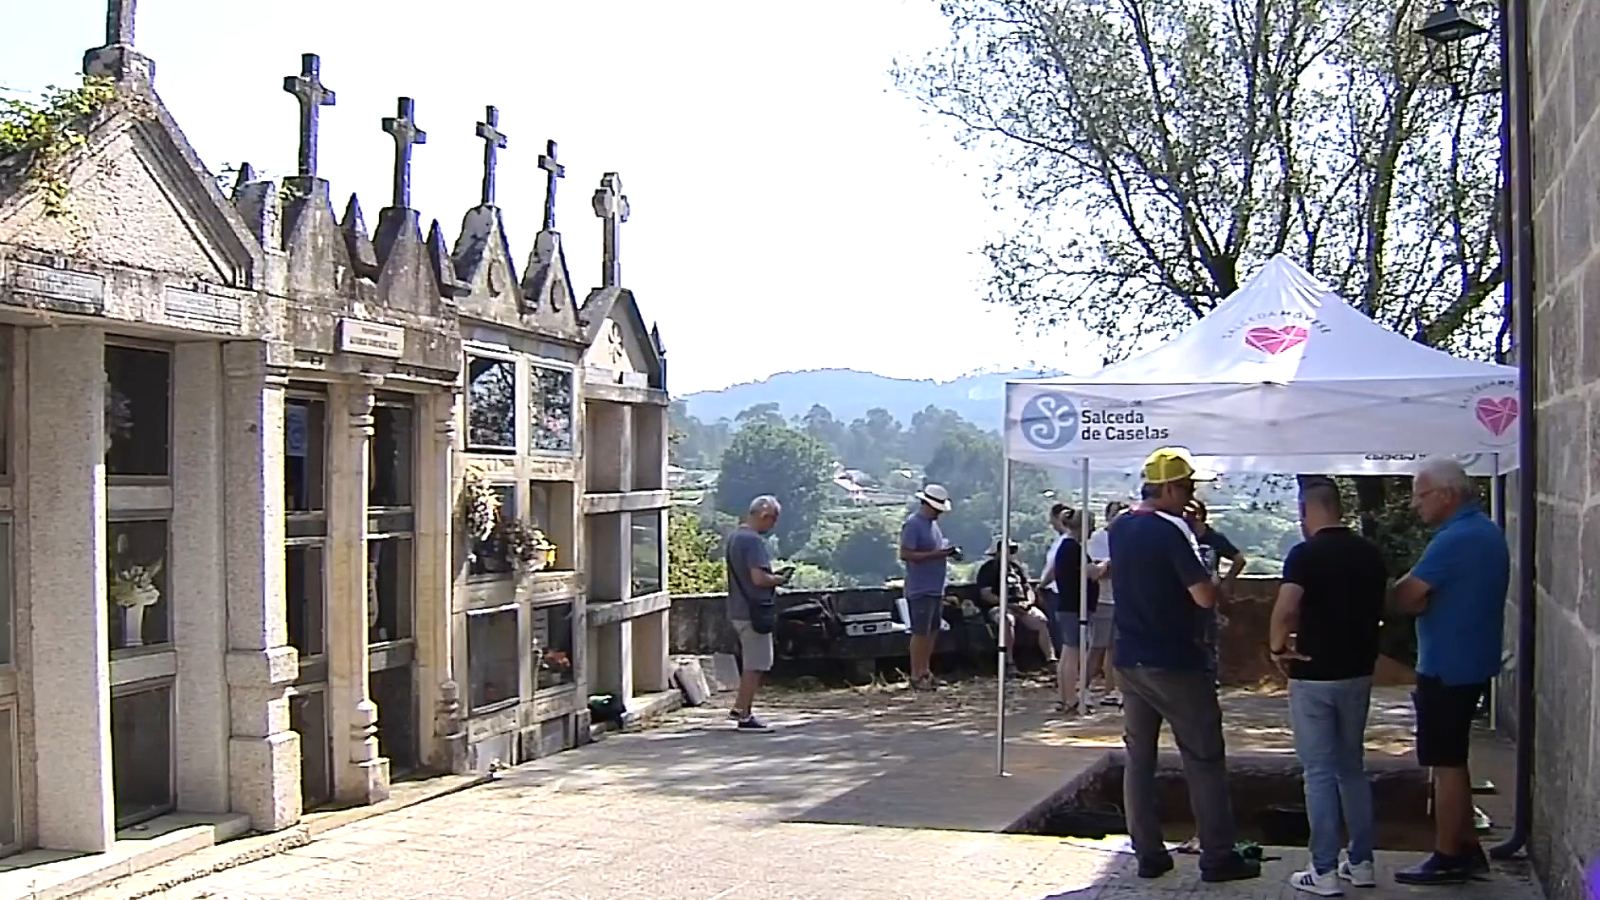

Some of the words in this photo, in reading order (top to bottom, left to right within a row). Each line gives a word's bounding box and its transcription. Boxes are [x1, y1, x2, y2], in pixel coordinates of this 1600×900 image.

[1081, 410, 1145, 424] Salceda
[1081, 426, 1101, 440] de
[1105, 426, 1169, 441] Caselas
